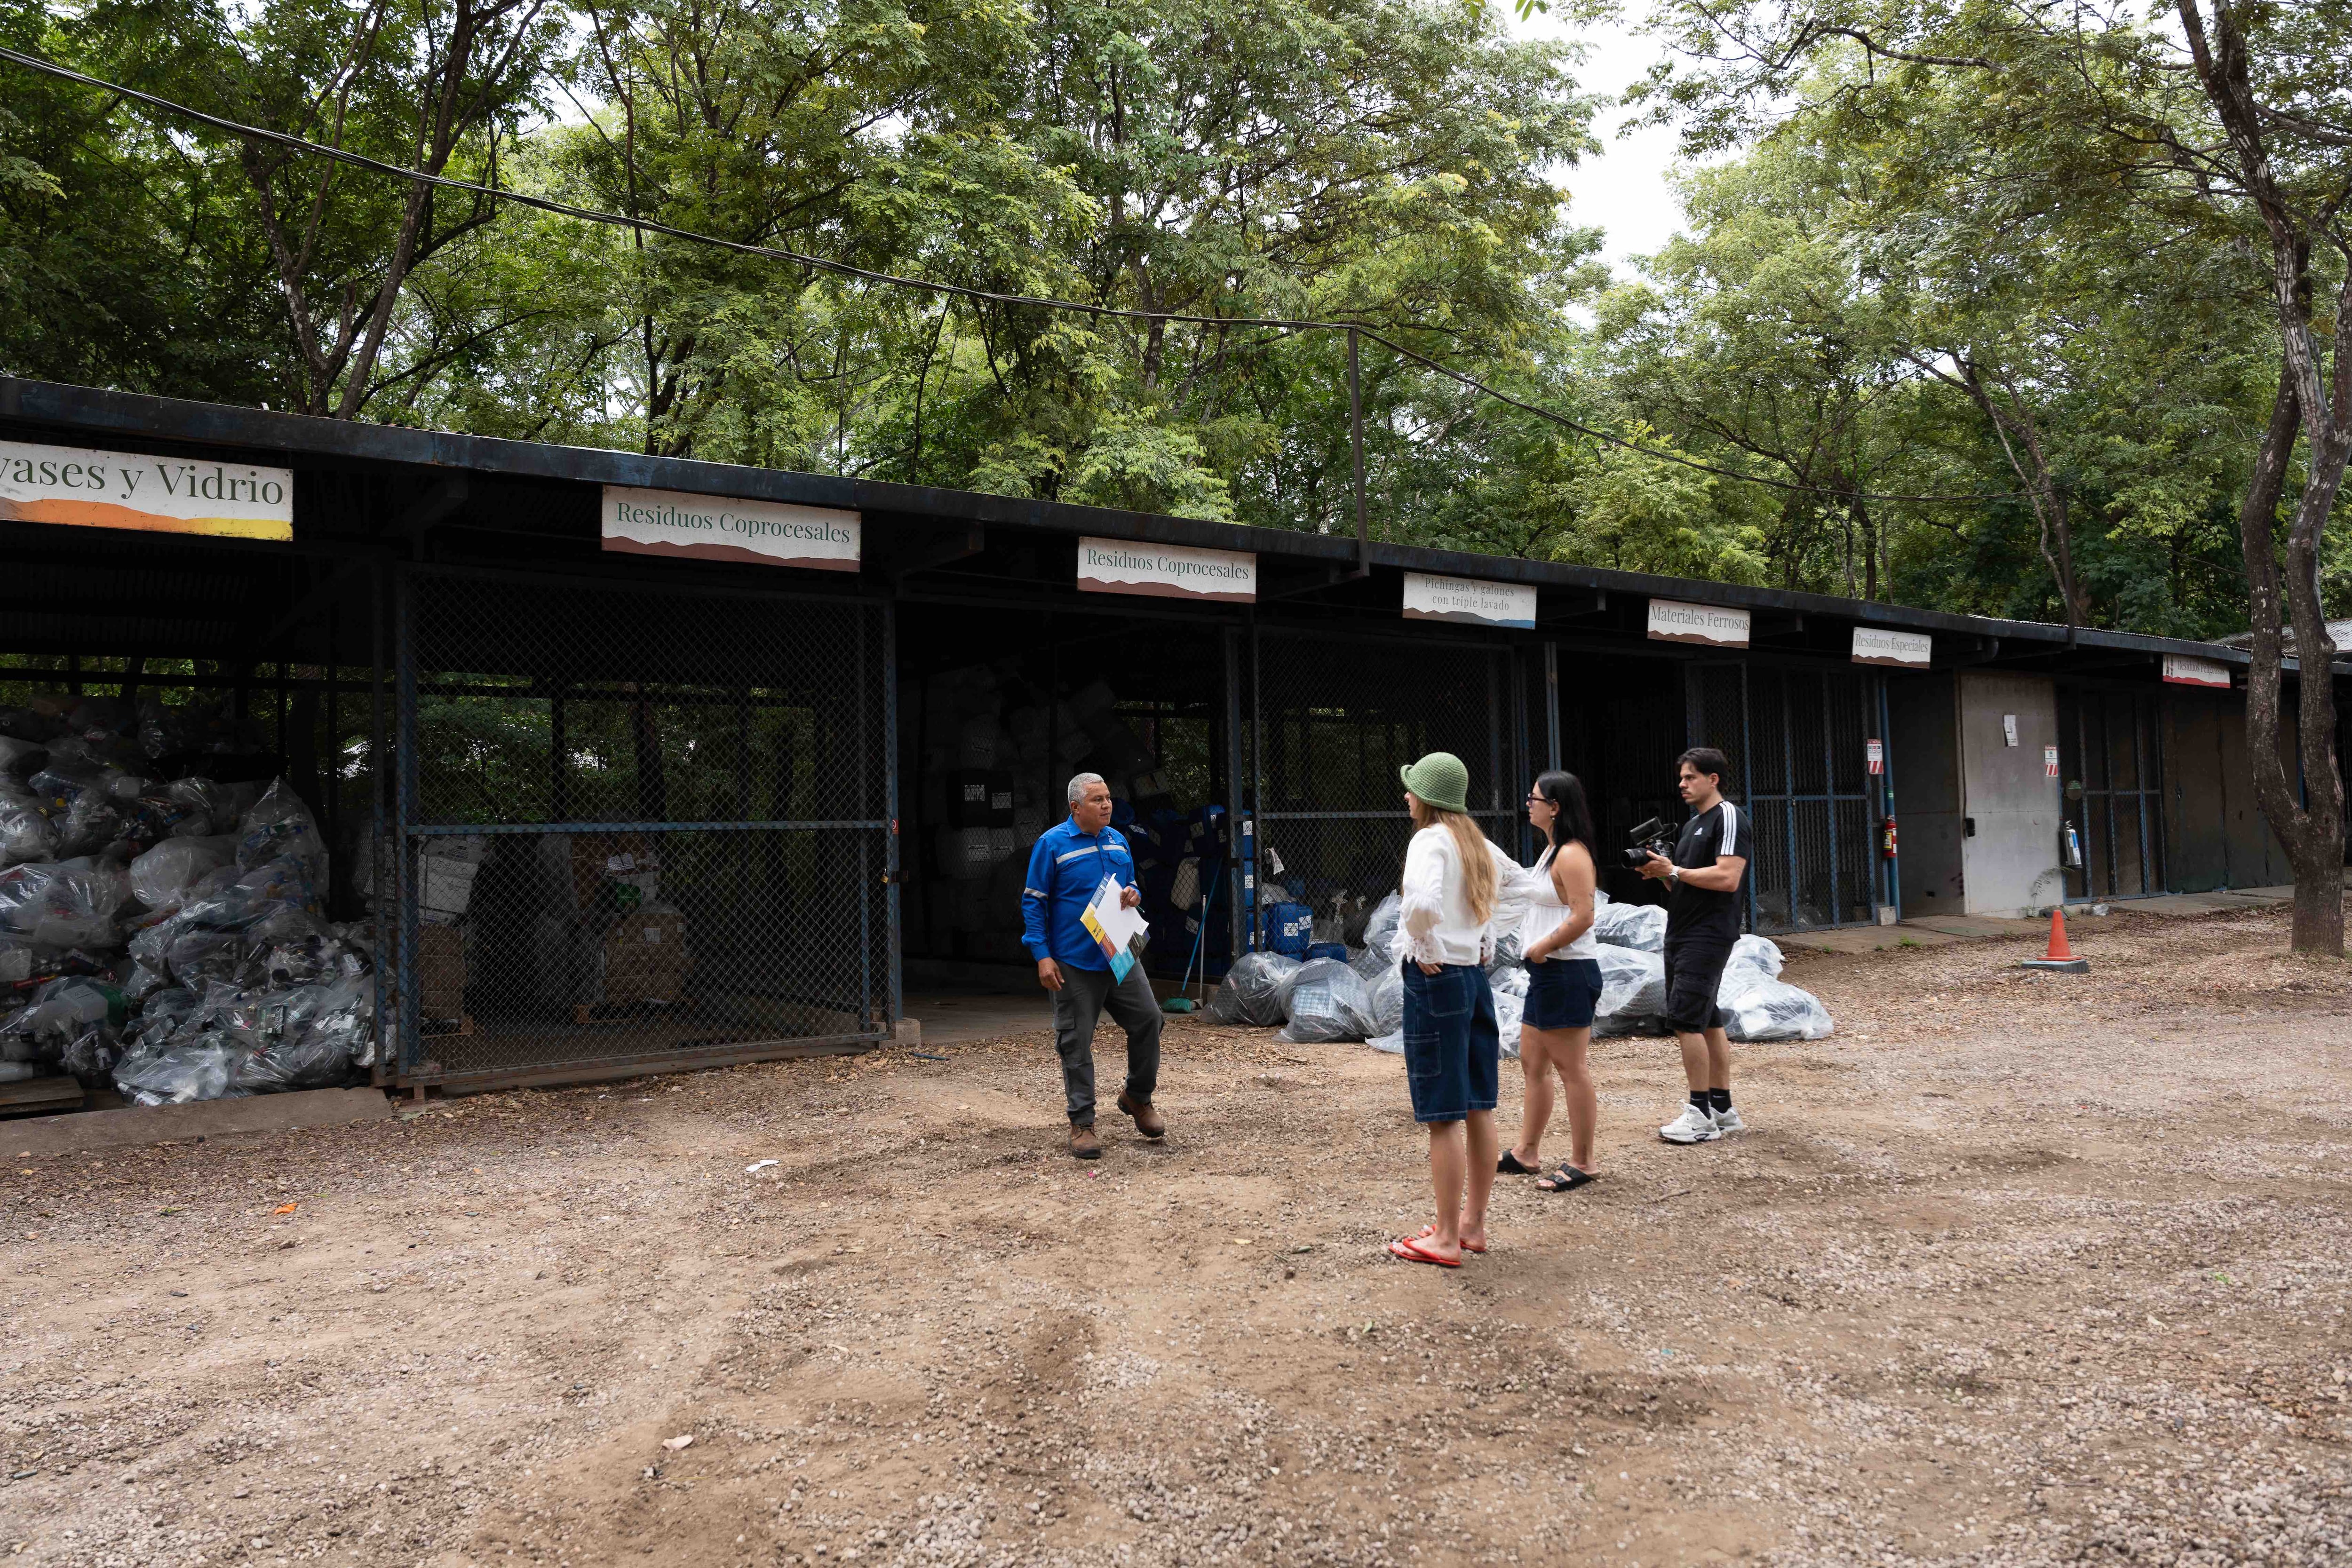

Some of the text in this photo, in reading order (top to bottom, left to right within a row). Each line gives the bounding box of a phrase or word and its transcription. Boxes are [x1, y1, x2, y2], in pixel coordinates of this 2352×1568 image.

[119, 468, 143, 499] y
[156, 464, 283, 505] Vidrio
[617, 502, 850, 543] Residuos Coprocesales
[1087, 549, 1248, 579] Residuos Coprocesales
[1425, 578, 1514, 597] Pichingas y galones
[1432, 595, 1509, 610] con triple lavado
[1652, 606, 1749, 631] Materiales Ferrosos
[1855, 634, 1928, 653] Residuos Especiales
[2178, 660, 2199, 672] Residuos
